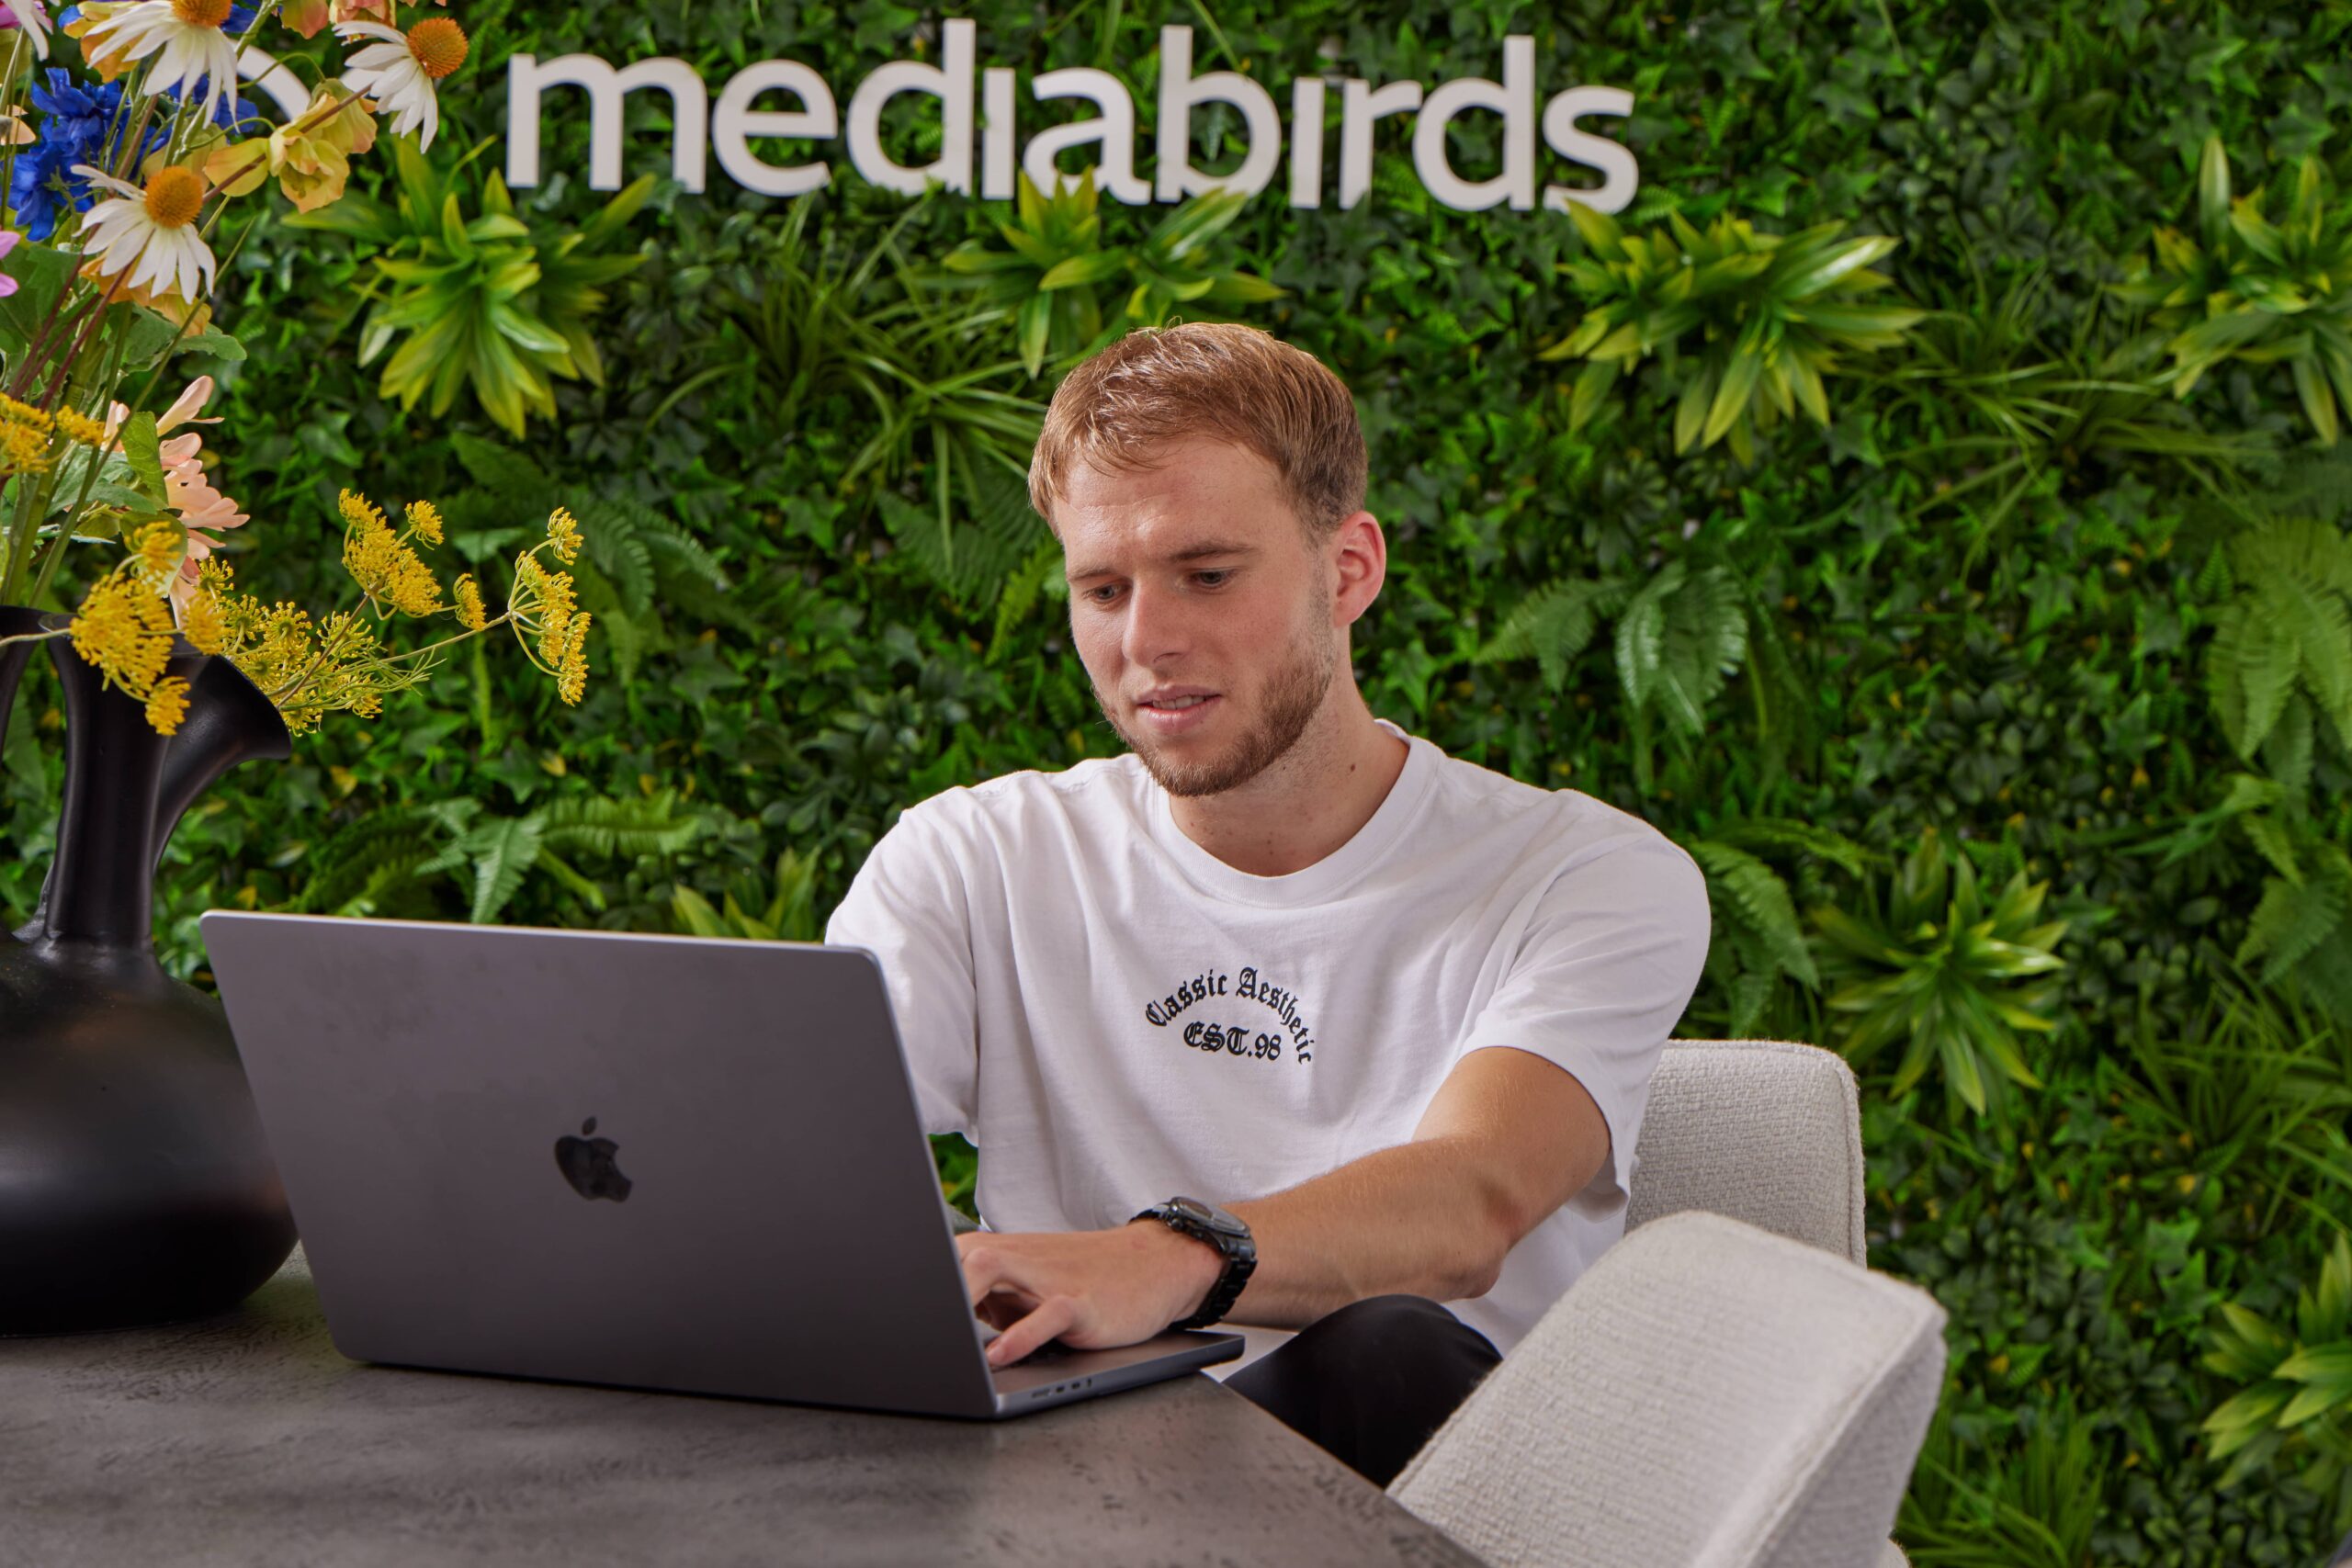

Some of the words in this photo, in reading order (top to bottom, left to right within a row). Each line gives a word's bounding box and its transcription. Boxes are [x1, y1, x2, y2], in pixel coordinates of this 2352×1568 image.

[506, 17, 1640, 215] mediabirds
[1145, 968, 1228, 1027] Classic
[1235, 966, 1315, 1065] Aesthetic
[1182, 1021, 1282, 1061] EST.98
